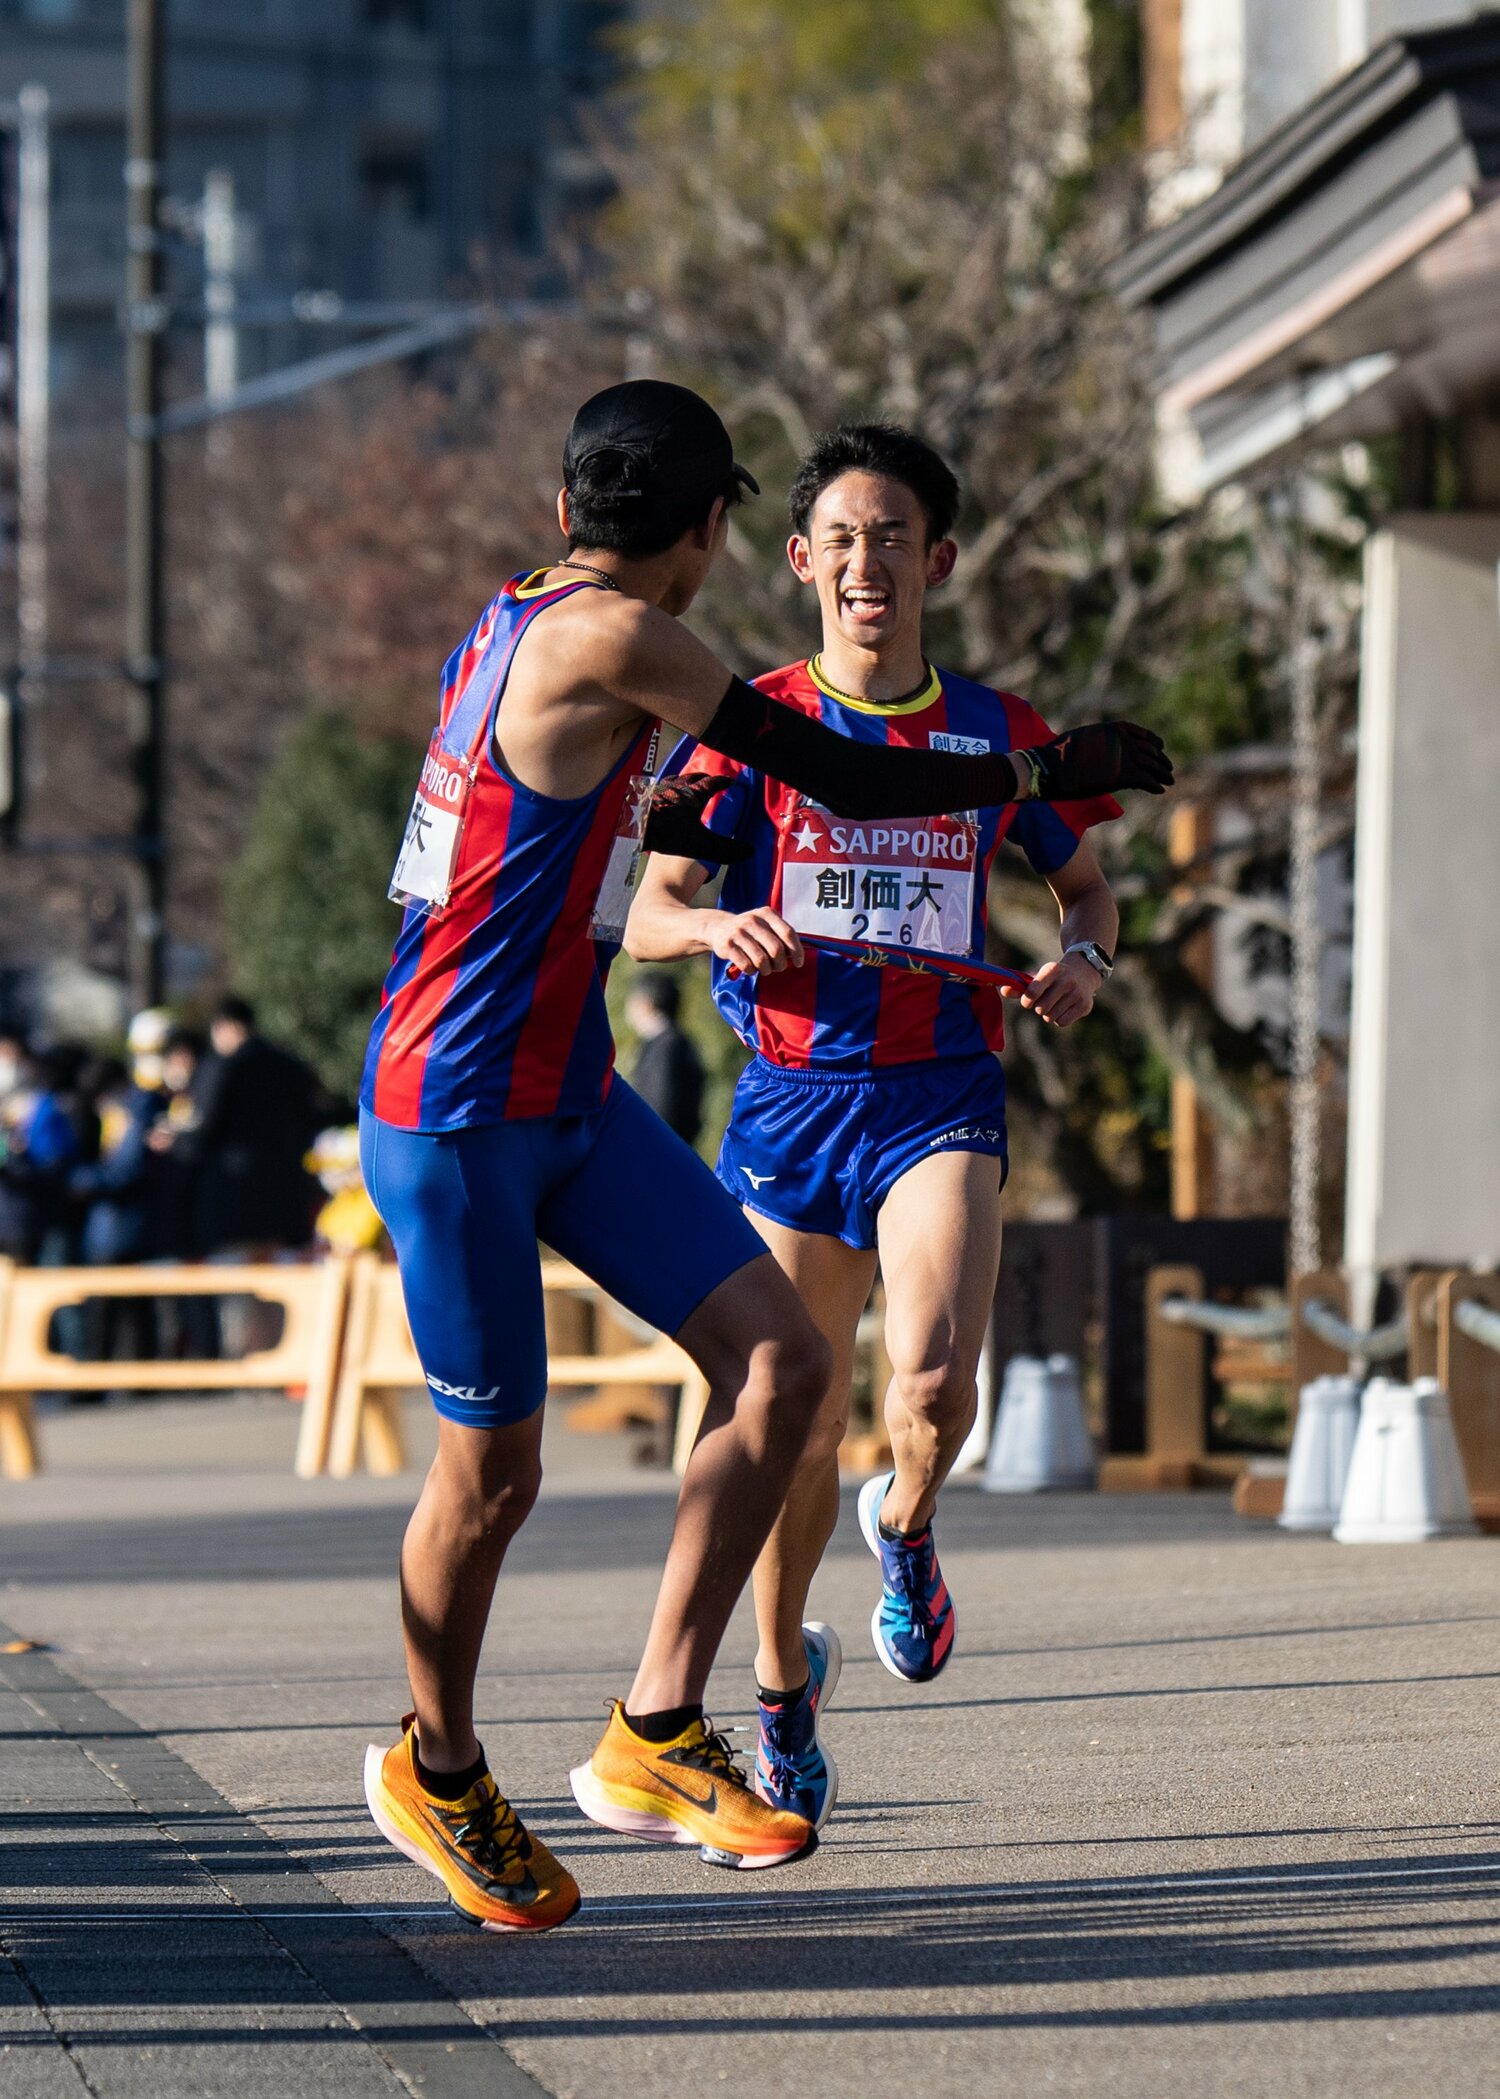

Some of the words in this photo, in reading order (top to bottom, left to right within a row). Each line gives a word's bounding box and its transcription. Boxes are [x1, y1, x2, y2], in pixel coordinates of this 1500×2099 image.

[829, 826, 968, 861] SAPPORO
[815, 867, 944, 914] 創価大
[426, 1371, 500, 1401] 2XU
